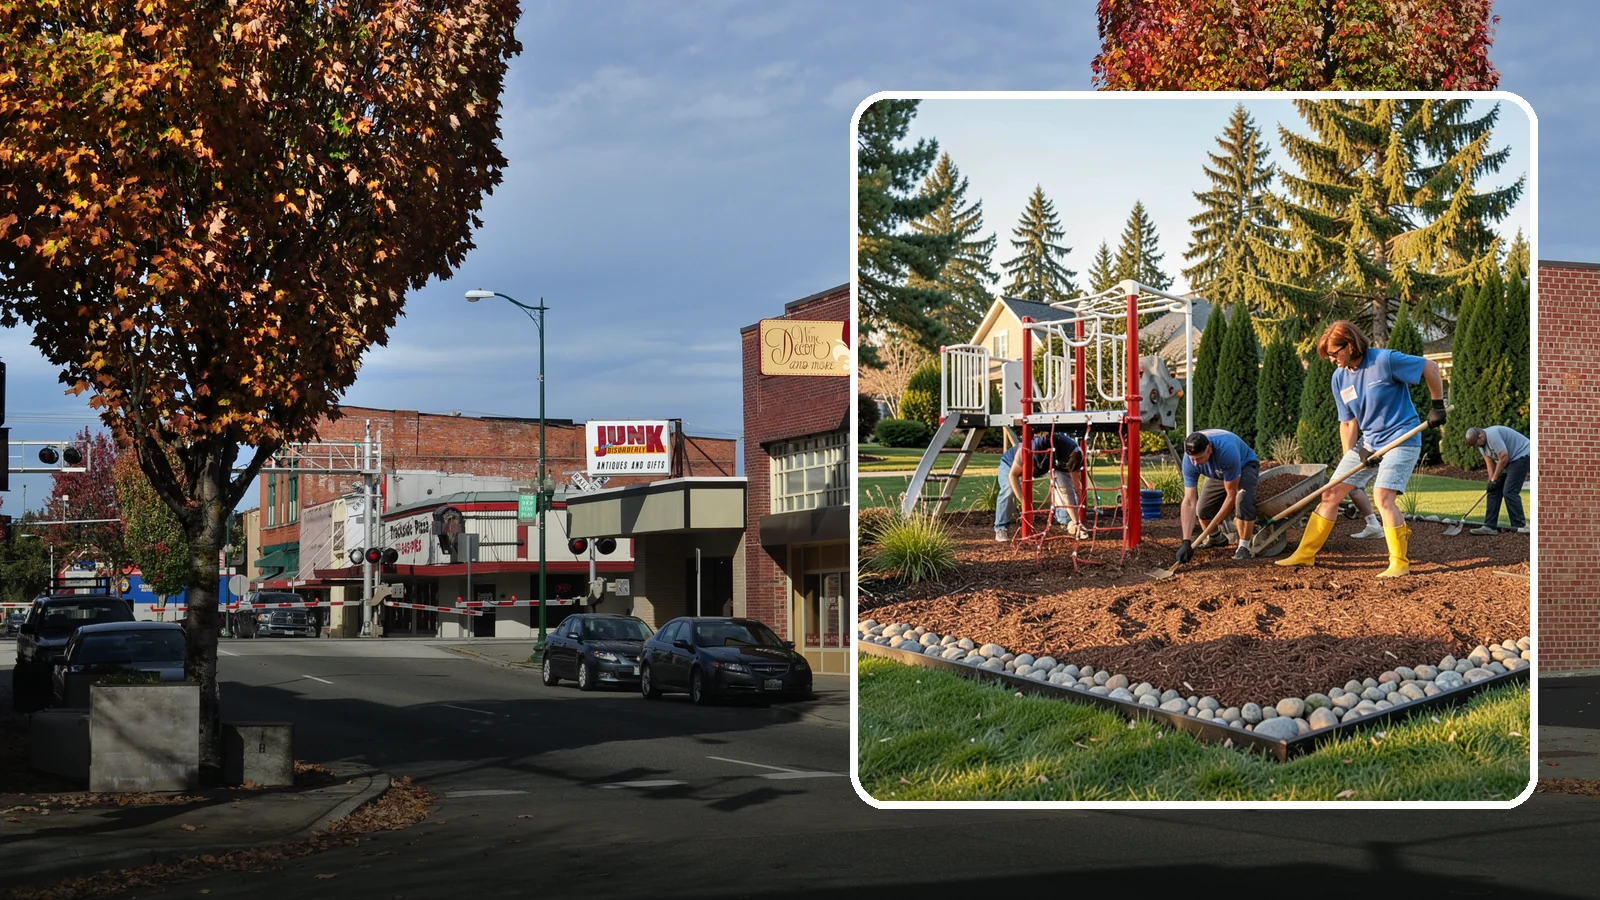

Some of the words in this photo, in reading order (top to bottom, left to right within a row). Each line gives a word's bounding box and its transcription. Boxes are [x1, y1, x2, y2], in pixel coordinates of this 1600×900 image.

[595, 425, 665, 457] JUNK
[607, 446, 646, 454] DISORDERLY
[597, 461, 628, 470] ANTIQUES
[631, 461, 643, 470] AND
[647, 460, 665, 470] GIFTS
[573, 474, 589, 492] RAIL
[590, 476, 608, 492] SING
[352, 498, 364, 511] CRO
[390, 520, 413, 540] Trackside
[414, 519, 429, 535] Pizza
